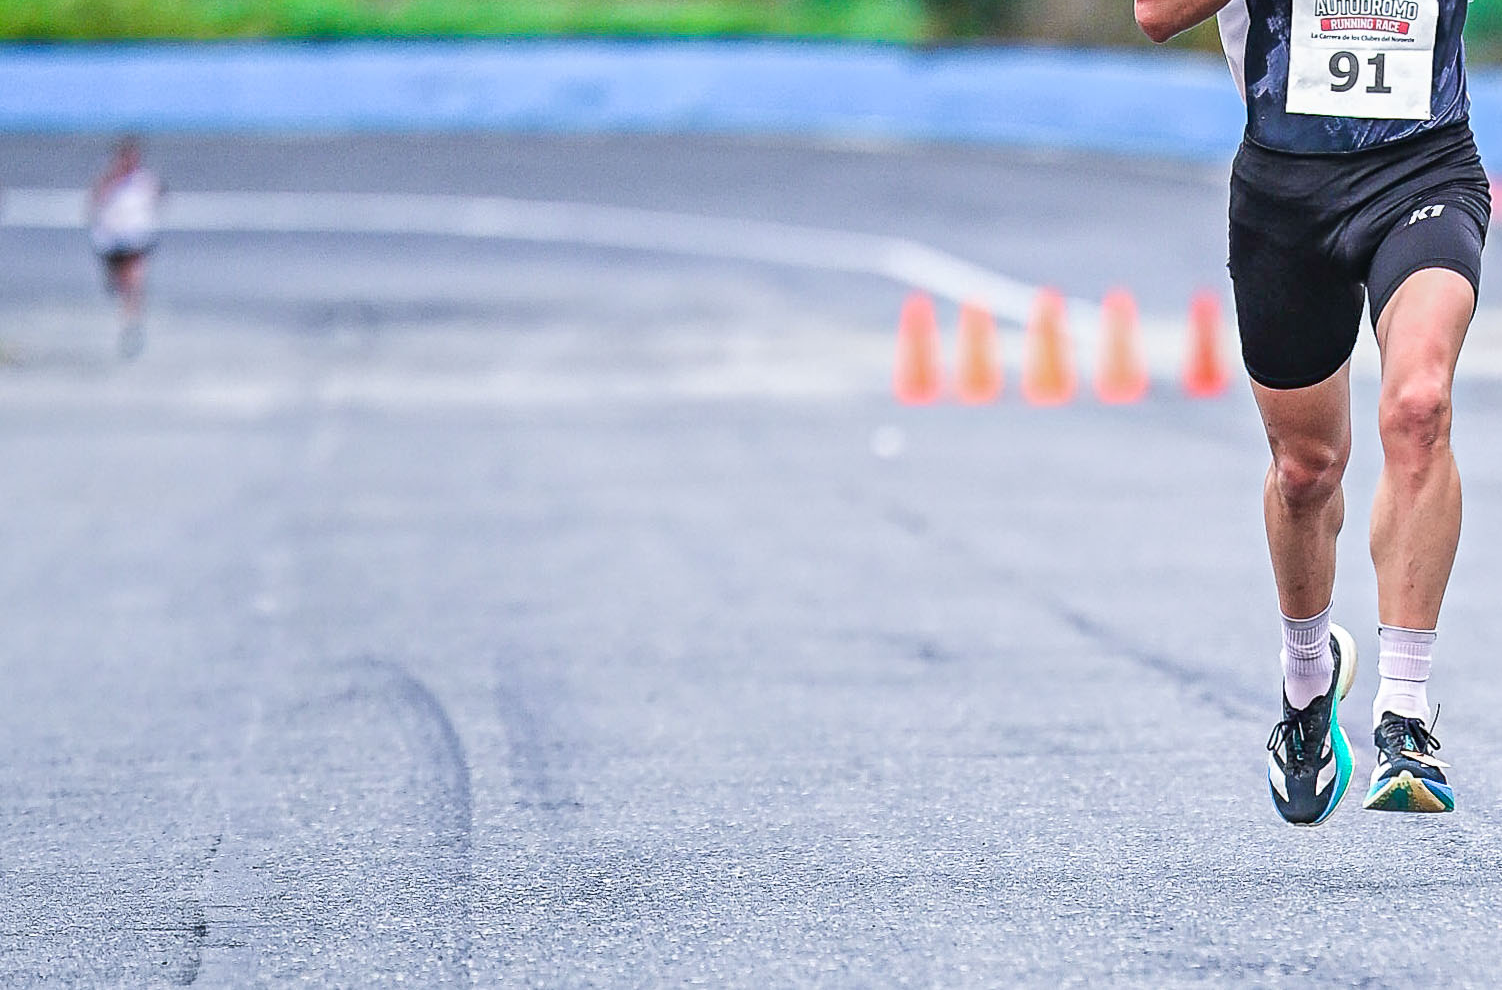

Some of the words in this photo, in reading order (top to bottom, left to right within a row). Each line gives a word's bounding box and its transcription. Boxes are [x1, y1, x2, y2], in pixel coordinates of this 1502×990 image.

[1330, 18, 1373, 30] RUNNING
[1375, 19, 1400, 33] RACE
[1328, 51, 1392, 94] 91
[1408, 204, 1446, 225] K1
